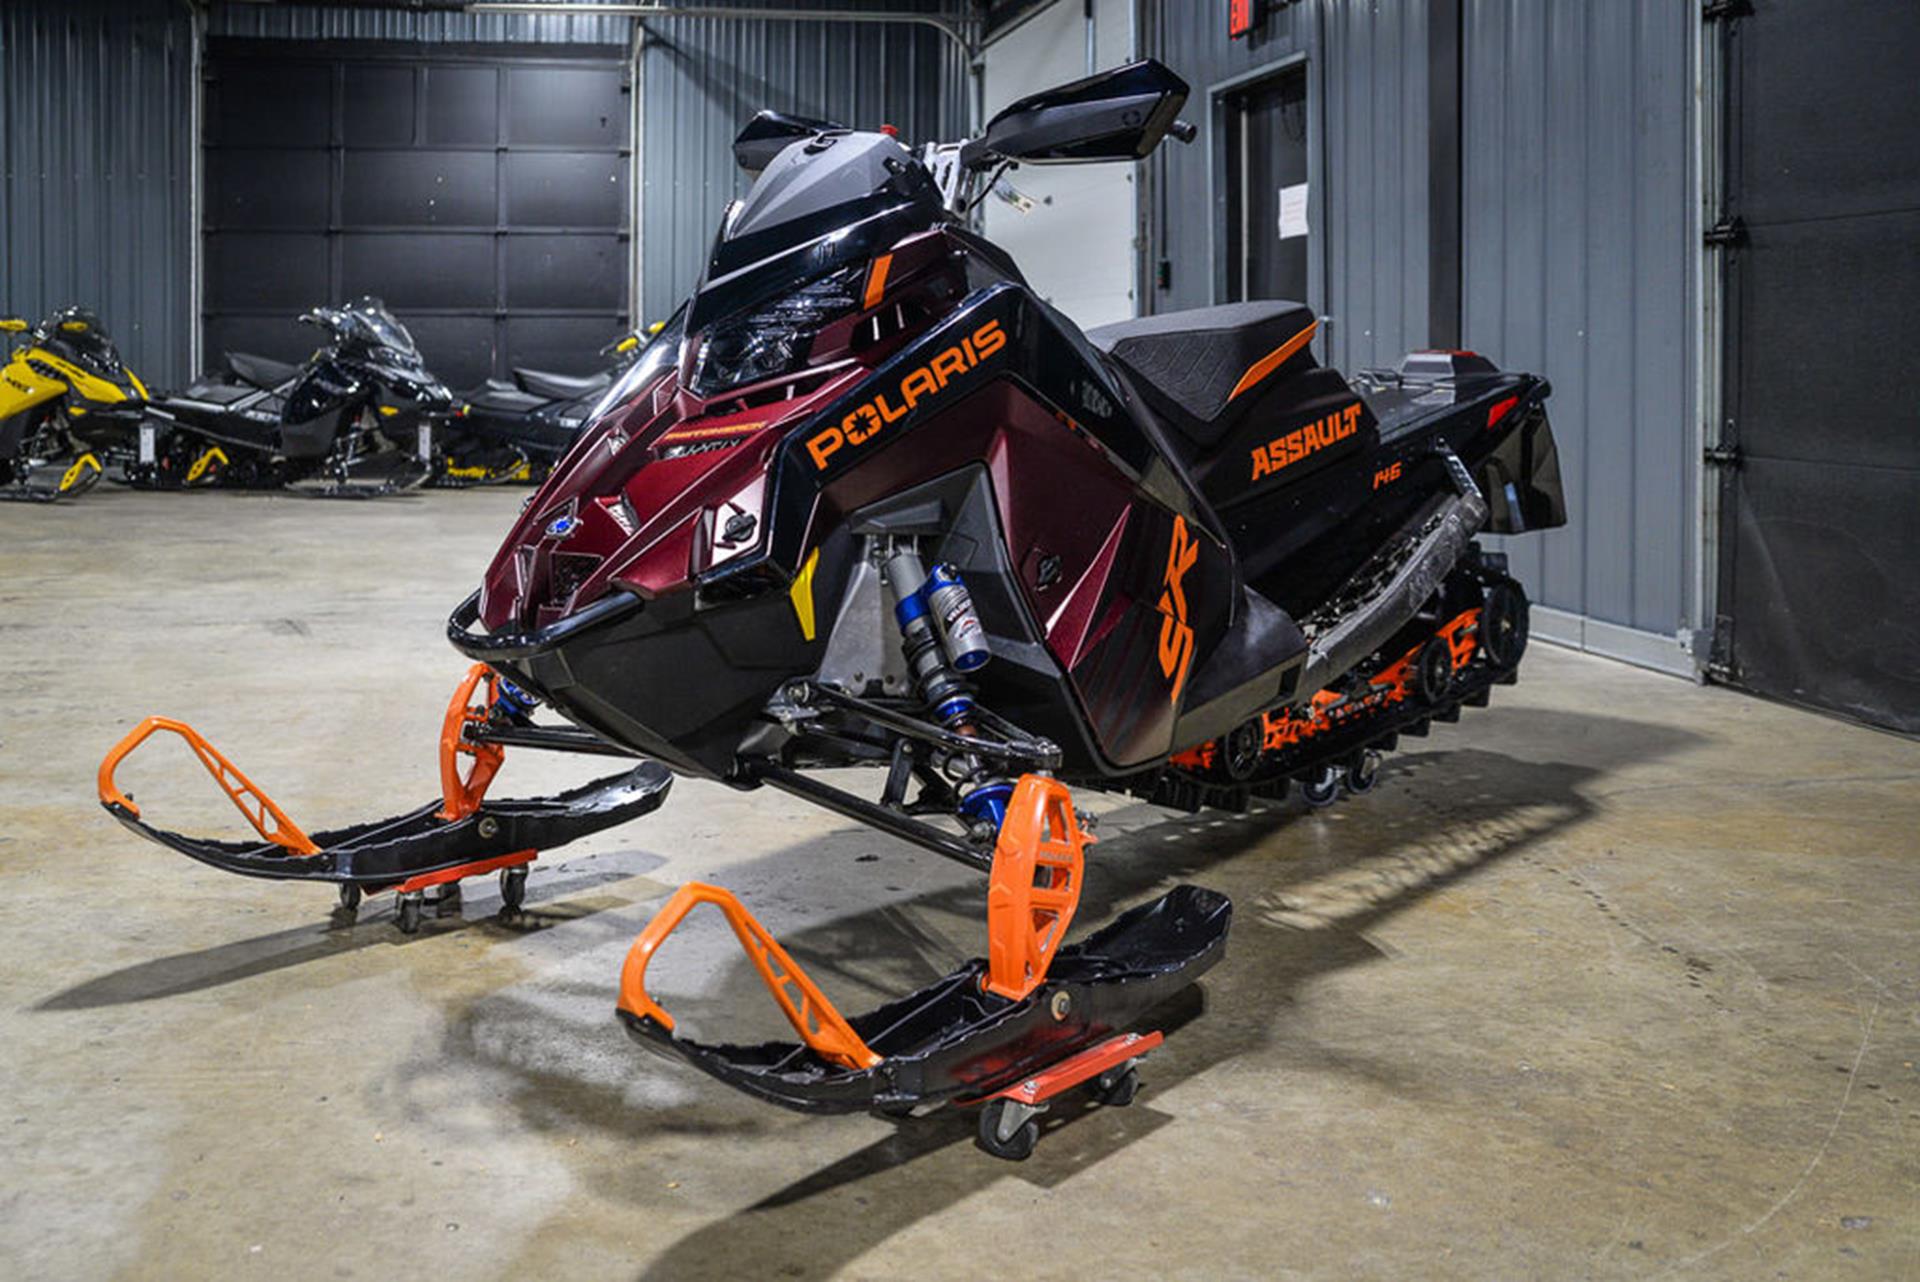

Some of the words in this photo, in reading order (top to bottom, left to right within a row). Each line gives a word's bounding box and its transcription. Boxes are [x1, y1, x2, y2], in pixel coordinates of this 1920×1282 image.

[805, 318, 1007, 471] POLARIS
[1249, 402, 1362, 481] ASSAULT
[1373, 461, 1402, 490] 146
